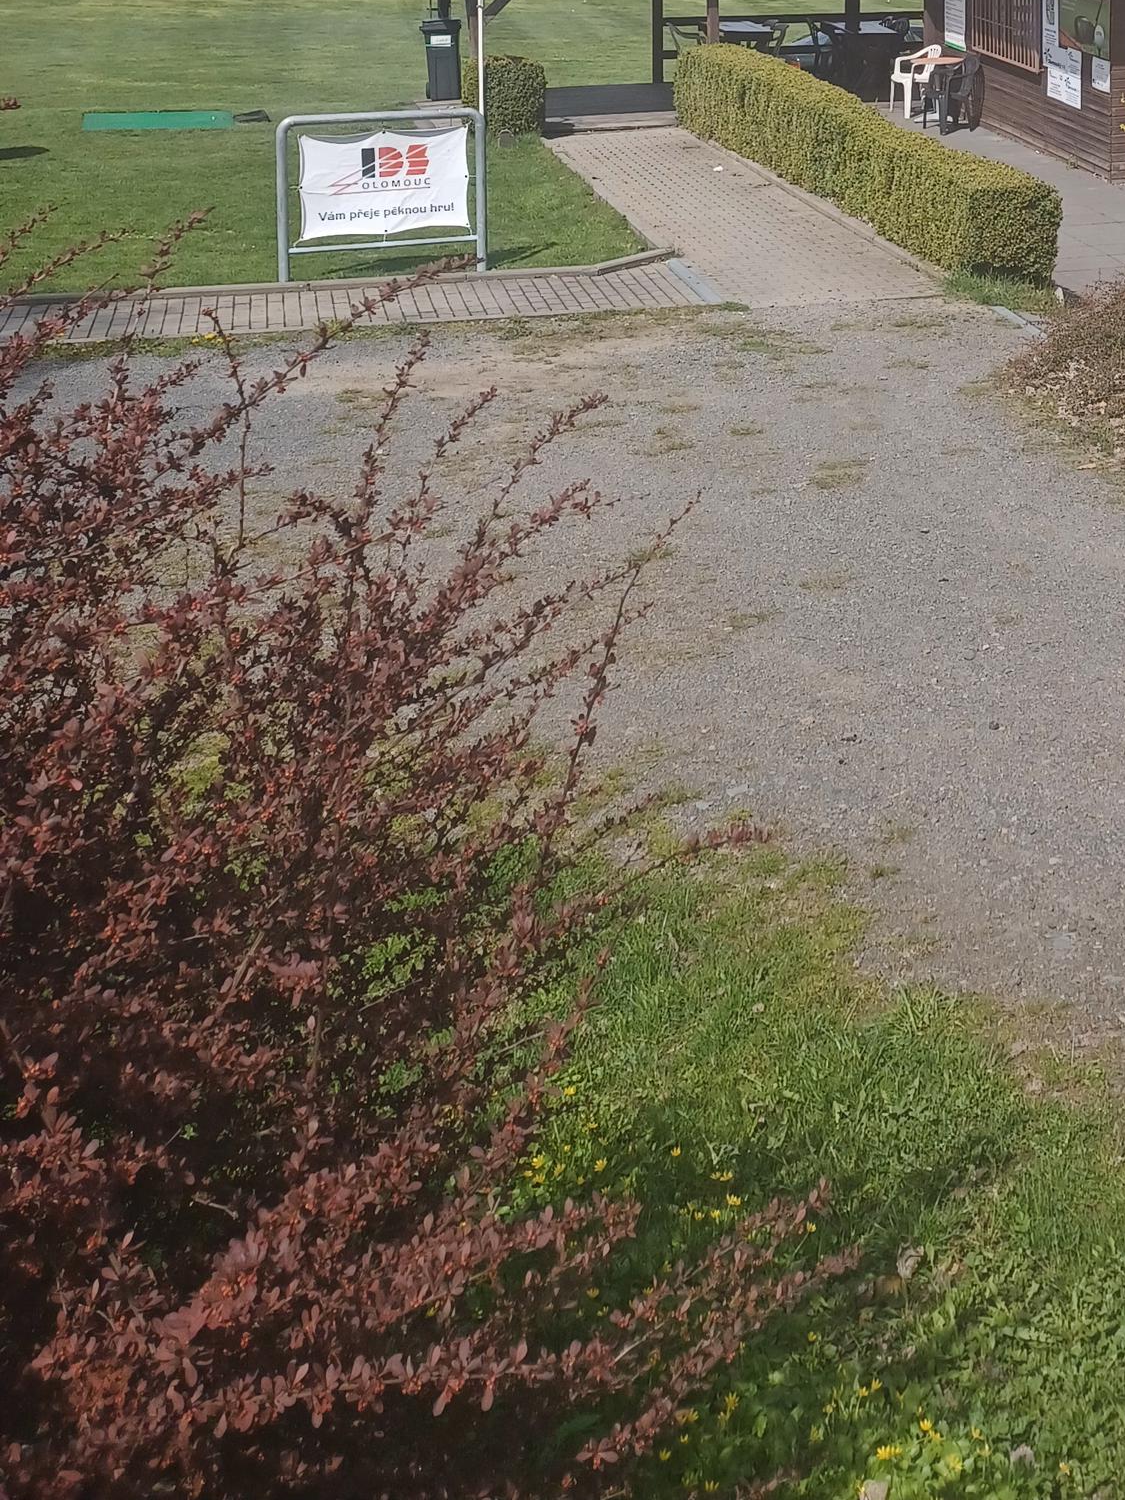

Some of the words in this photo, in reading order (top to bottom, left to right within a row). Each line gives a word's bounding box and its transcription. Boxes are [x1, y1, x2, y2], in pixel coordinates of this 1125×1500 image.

[362, 177, 431, 190] OLOMOUC
[318, 211, 346, 222] Vám
[349, 208, 381, 221] přeje
[383, 205, 427, 219] pěknou
[430, 202, 455, 212] hru!
